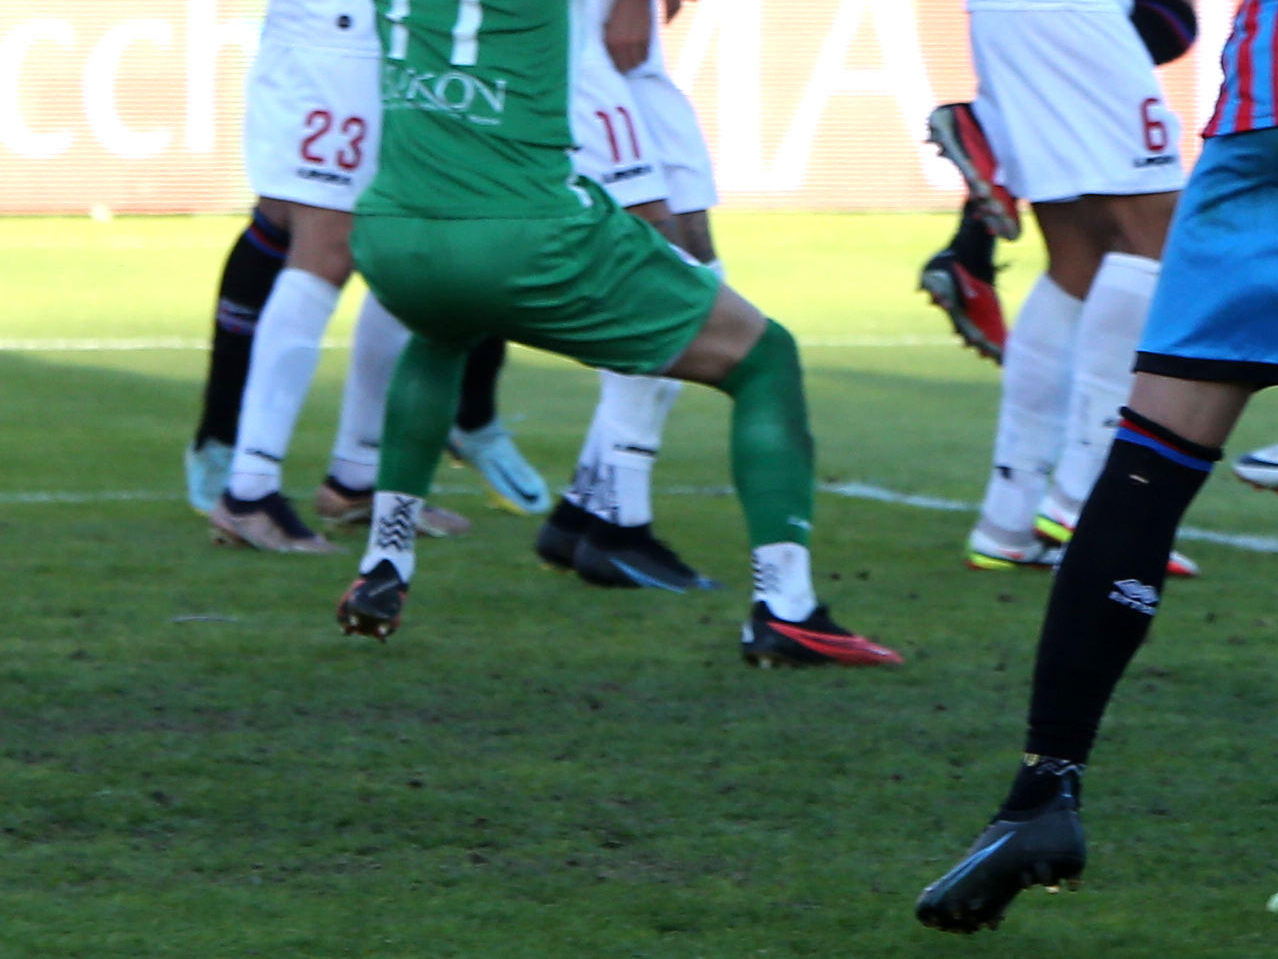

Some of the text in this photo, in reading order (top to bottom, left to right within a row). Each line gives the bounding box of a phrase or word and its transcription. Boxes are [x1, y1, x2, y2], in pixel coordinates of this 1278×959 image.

[301, 110, 366, 170] 23
[594, 106, 640, 163] 11
[1140, 97, 1168, 151] 6
